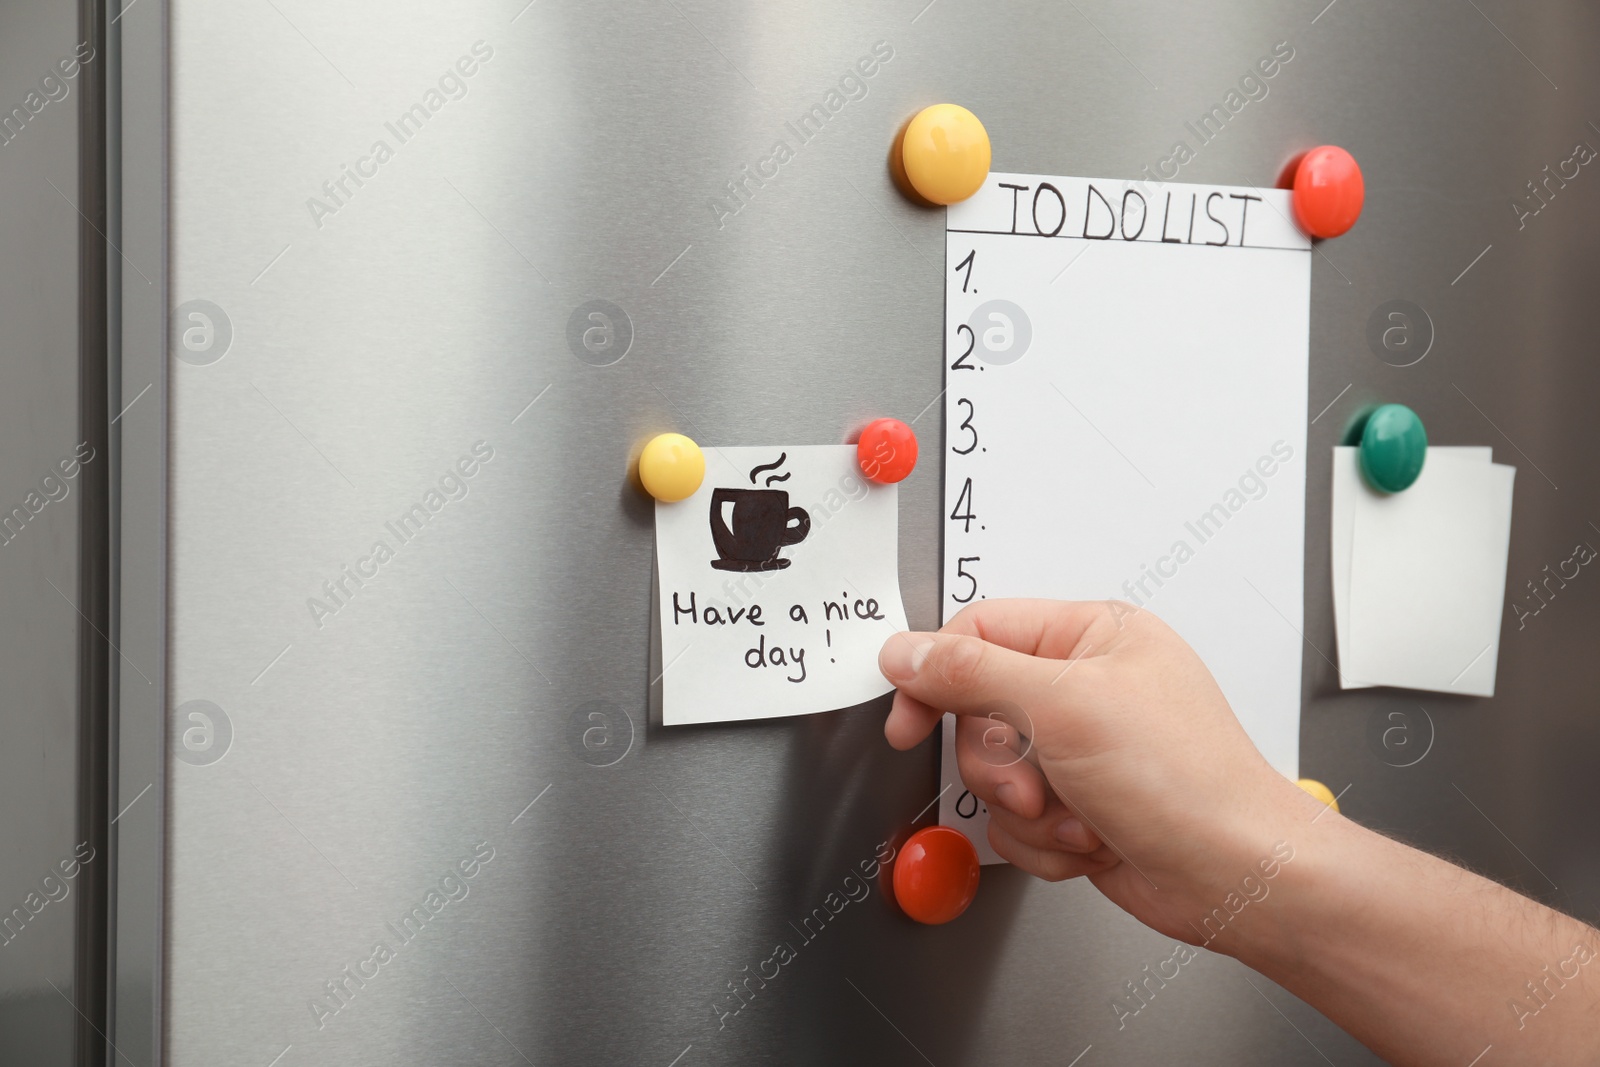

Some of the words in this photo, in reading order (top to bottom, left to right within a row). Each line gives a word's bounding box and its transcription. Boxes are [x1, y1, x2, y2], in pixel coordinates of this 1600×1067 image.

[998, 182, 1067, 237] TO
[1082, 184, 1147, 241] DO
[1161, 190, 1263, 247] LIST
[955, 249, 978, 294] 1.
[951, 323, 984, 371] 2.
[952, 397, 987, 455] 3.
[950, 477, 985, 533] 4.
[952, 556, 986, 603] 5.
[673, 592, 765, 626] Have
[789, 604, 808, 624] a
[823, 591, 885, 620] nice
[744, 634, 806, 683] day
